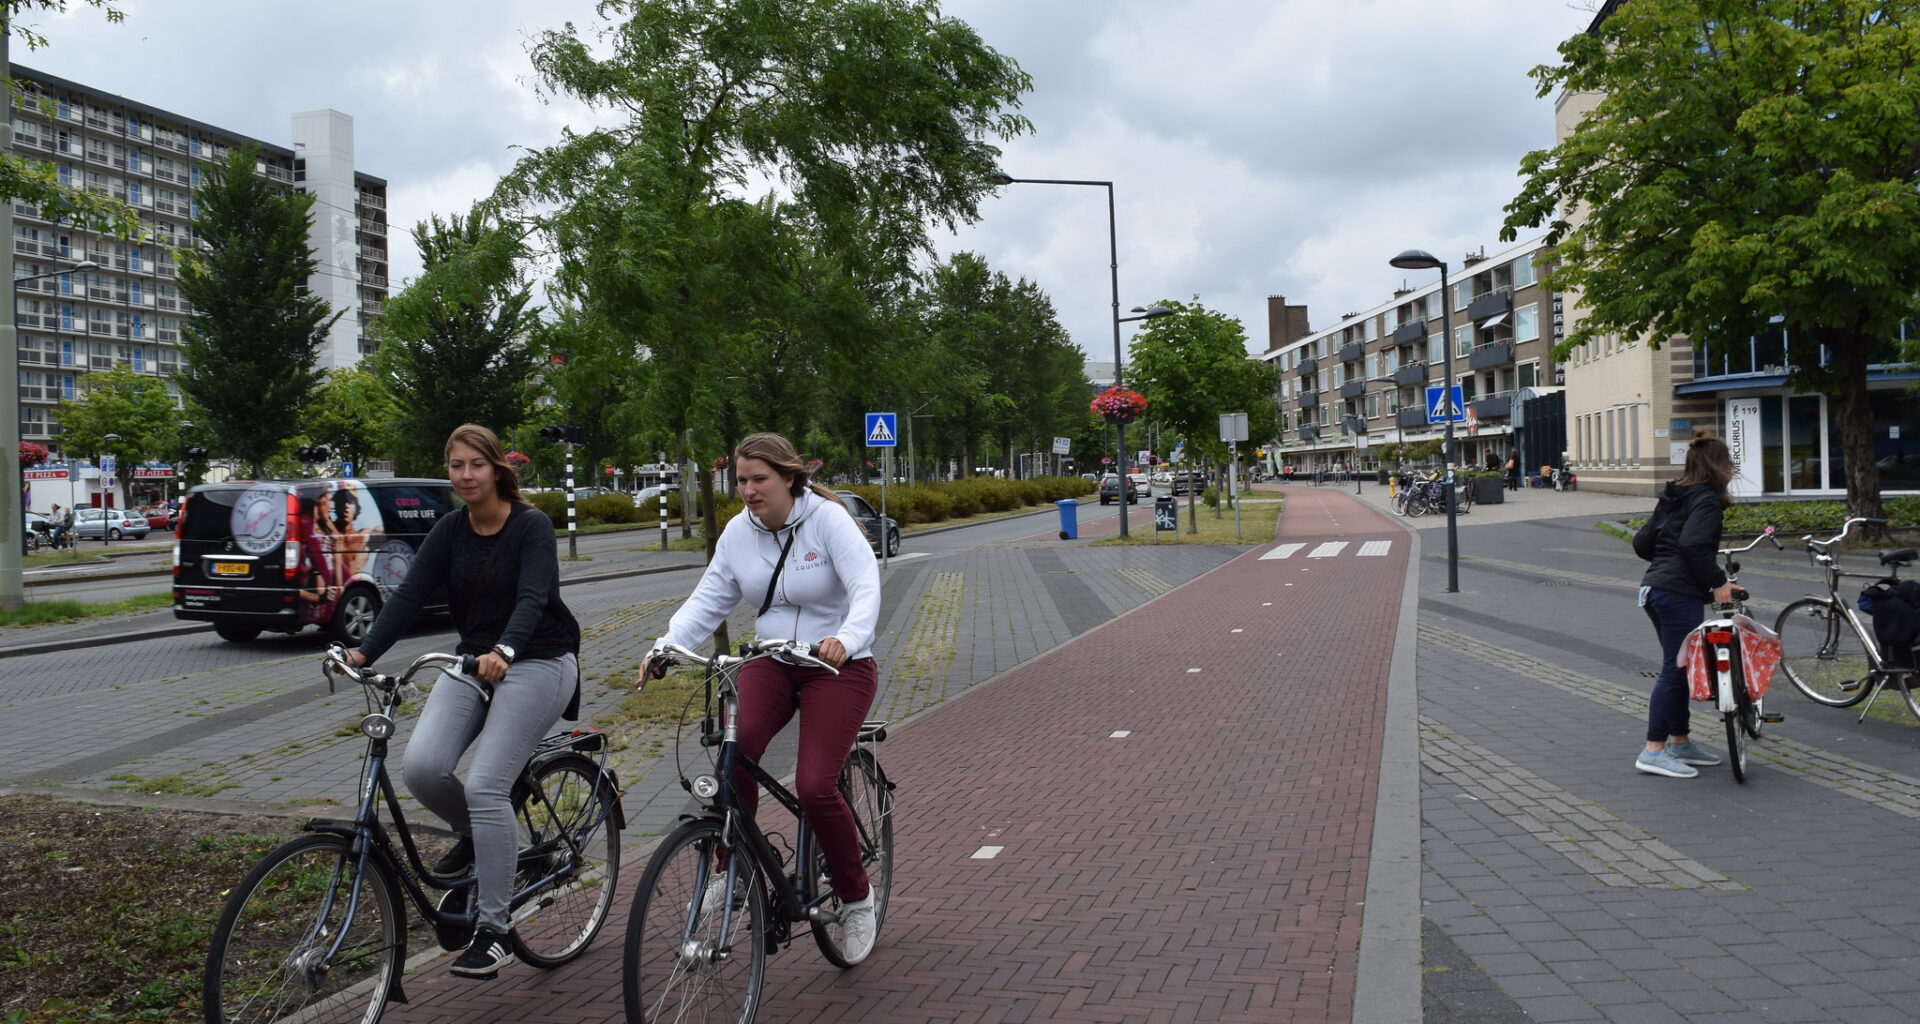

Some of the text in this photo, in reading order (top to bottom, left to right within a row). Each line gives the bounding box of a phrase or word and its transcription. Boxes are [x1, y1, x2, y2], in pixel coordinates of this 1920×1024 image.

[1552, 266, 1565, 386] STAUNT
[1741, 407, 1757, 415] 119
[1731, 420, 1741, 475] MERCURIUS
[398, 510, 435, 518] YOUR LIFE
[795, 560, 829, 571] EQUINIX
